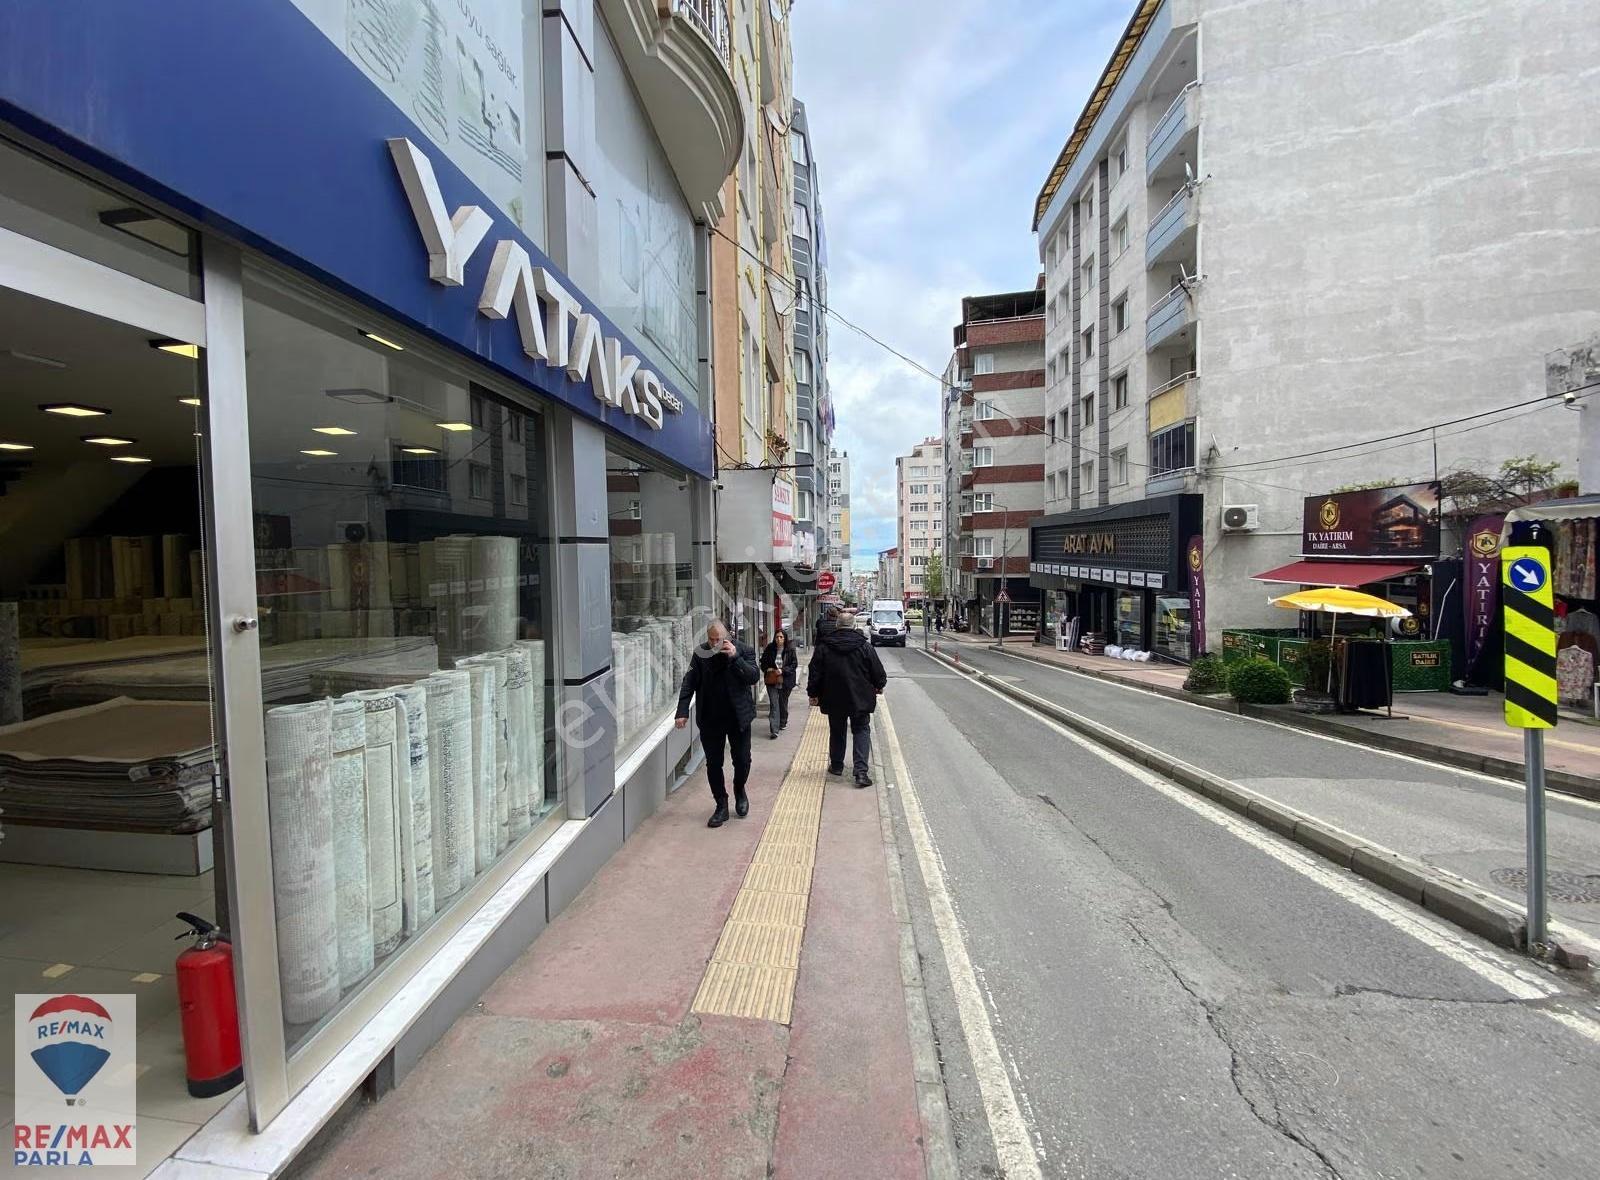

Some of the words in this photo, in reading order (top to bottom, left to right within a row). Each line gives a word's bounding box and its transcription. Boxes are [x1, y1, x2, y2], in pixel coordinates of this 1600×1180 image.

[485, 34, 518, 89] sağlar.
[386, 137, 664, 430] YATAKS
[1063, 534, 1087, 553] ARAT
[1090, 533, 1115, 554] AVM
[1307, 532, 1318, 541] TK
[1319, 531, 1352, 541] YATIRIM
